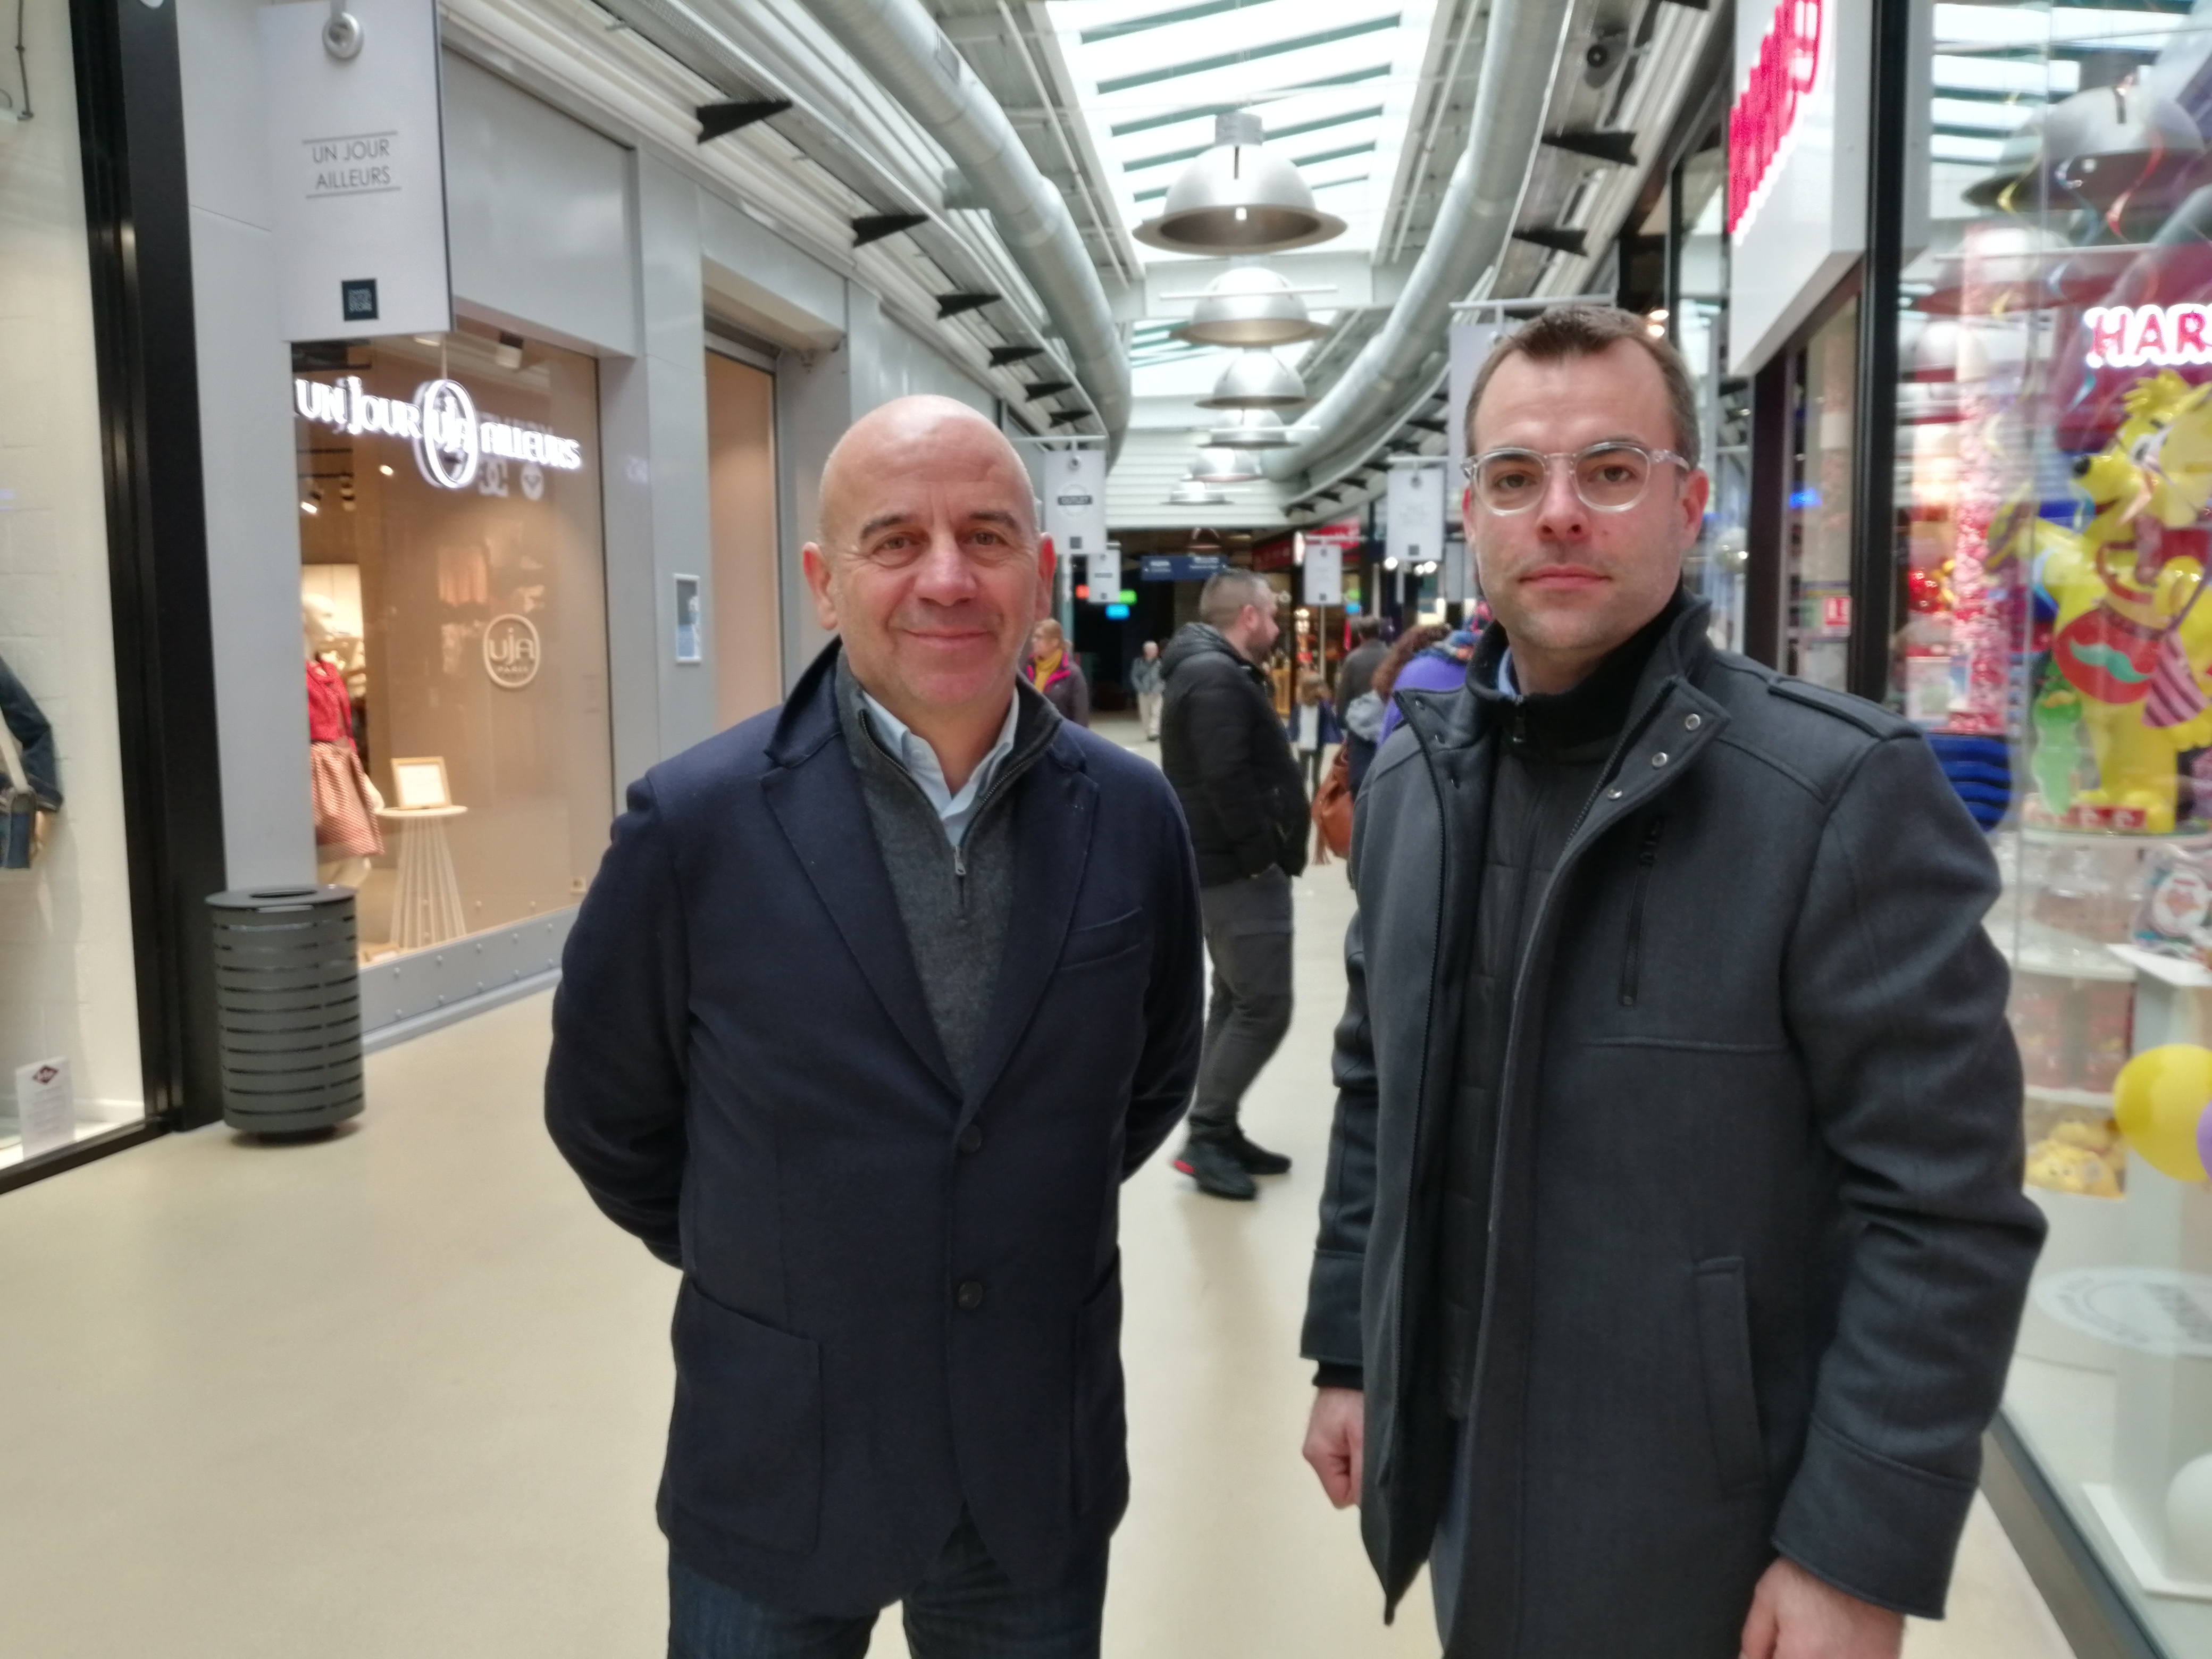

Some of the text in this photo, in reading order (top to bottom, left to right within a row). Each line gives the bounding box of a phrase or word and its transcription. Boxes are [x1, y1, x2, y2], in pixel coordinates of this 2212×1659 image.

[313, 139, 390, 164] UN JOUR
[316, 167, 391, 189] AILLEURS
